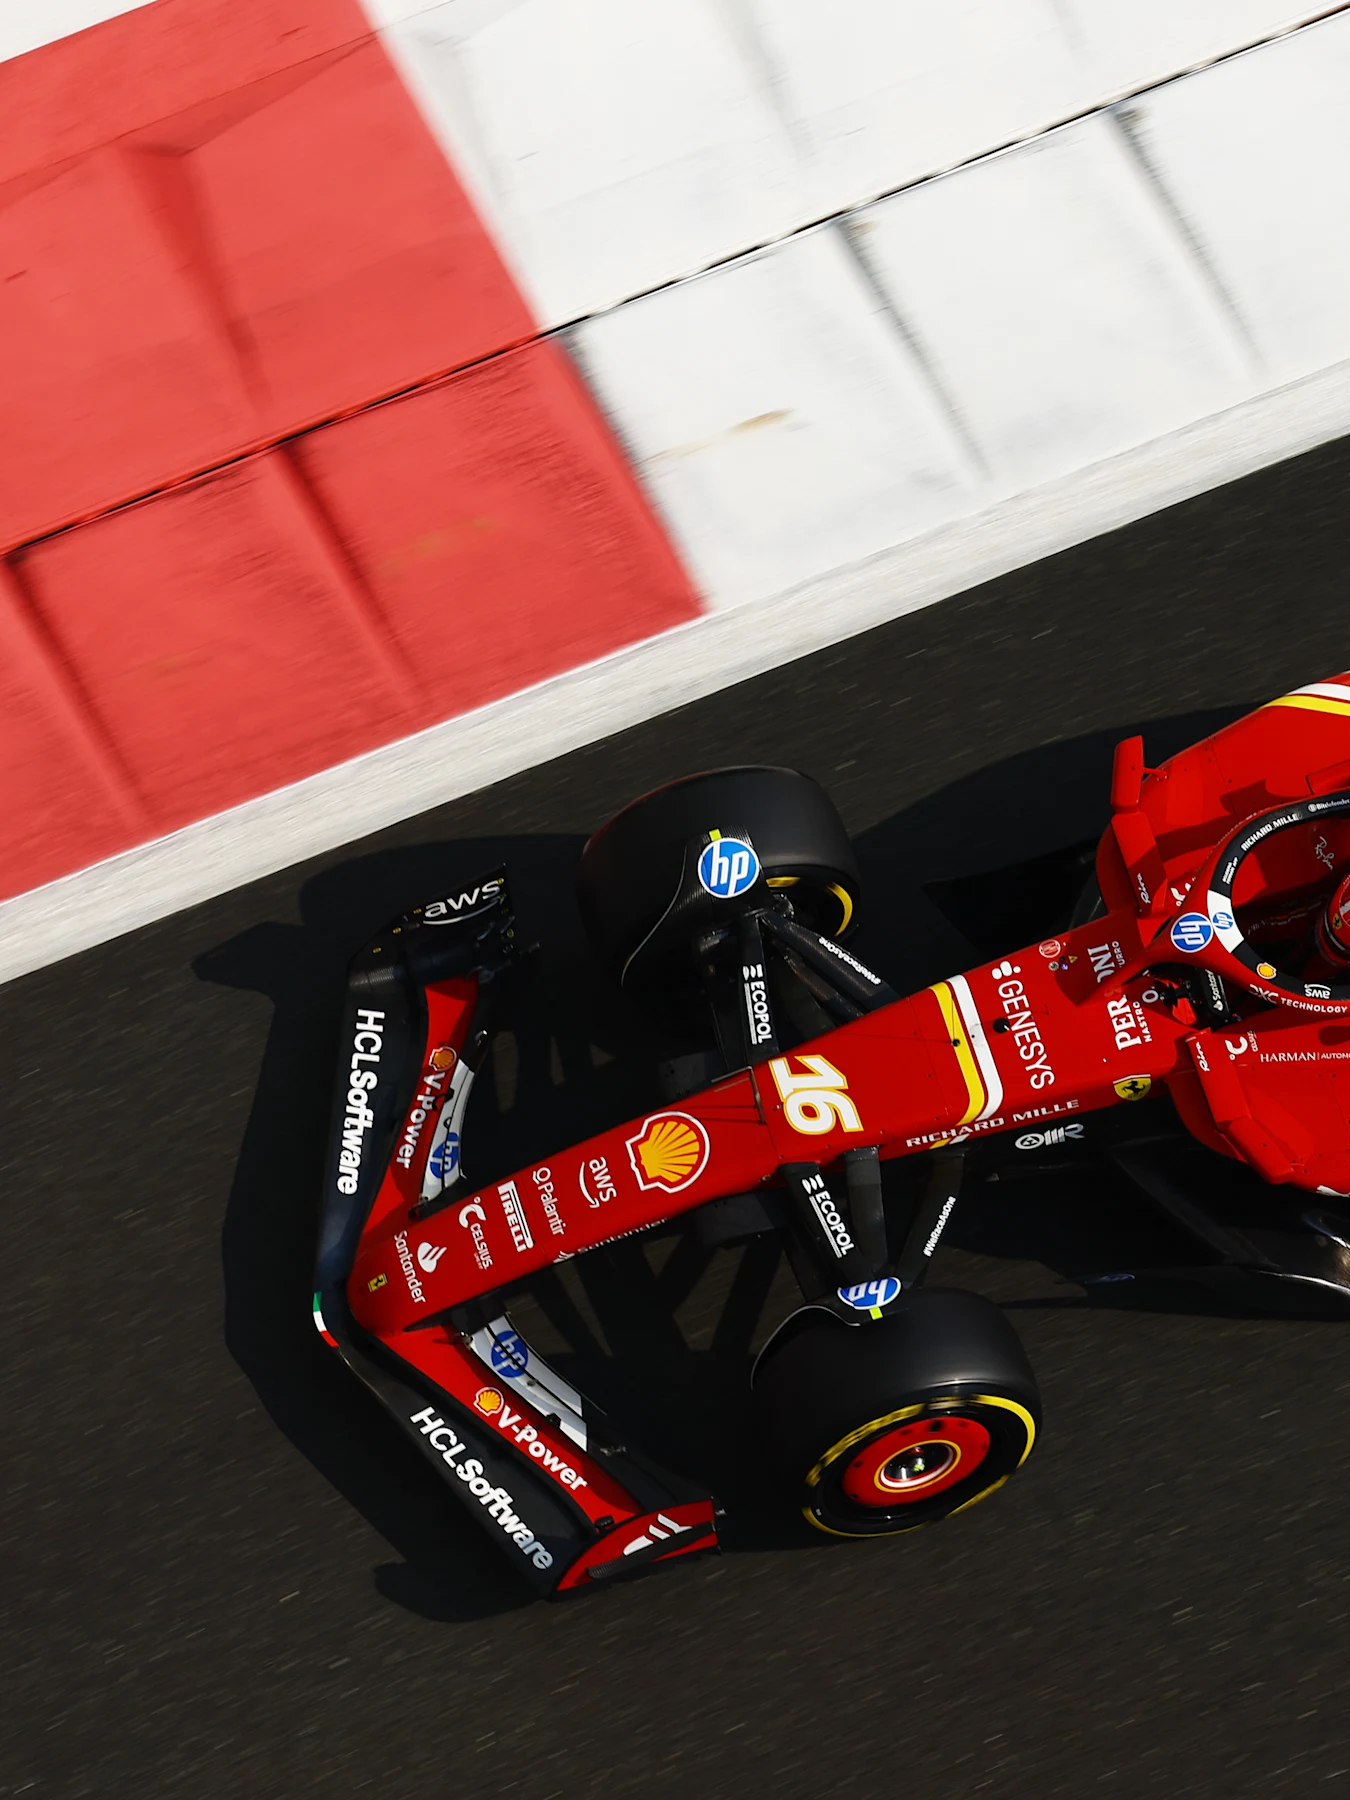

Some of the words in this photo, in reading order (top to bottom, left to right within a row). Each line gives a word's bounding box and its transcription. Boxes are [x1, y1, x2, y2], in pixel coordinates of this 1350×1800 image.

[1240, 823, 1274, 852] RICHARD
[1272, 813, 1299, 829] MILLE
[707, 838, 751, 898] hp
[424, 880, 501, 918] aws
[1171, 918, 1212, 948] hp
[750, 980, 774, 1044] ECOPOL
[1133, 1001, 1152, 1042] NASTRO
[1280, 997, 1348, 1013] TECHNOLOGY
[1305, 987, 1331, 999] aws
[998, 980, 1055, 1089] GENESYS
[1260, 1052, 1316, 1062] HARMAN
[337, 1009, 385, 1195] HCLSoftware
[397, 1072, 446, 1169] V-Power
[768, 1055, 864, 1135] 16
[907, 1117, 1004, 1147] RICHARD
[1013, 1100, 1080, 1122] MILLE
[538, 1181, 567, 1235] Palantir
[589, 1156, 617, 1203] aws
[497, 1180, 534, 1252] PIRELLI
[815, 1191, 855, 1256] ECOPOL
[923, 1195, 957, 1257] #WeRaceAsOne
[394, 1230, 426, 1303] Santander
[470, 1223, 493, 1270] CELSIUS
[498, 1405, 588, 1490] V-Power
[410, 1406, 554, 1569] HCLSoftware
